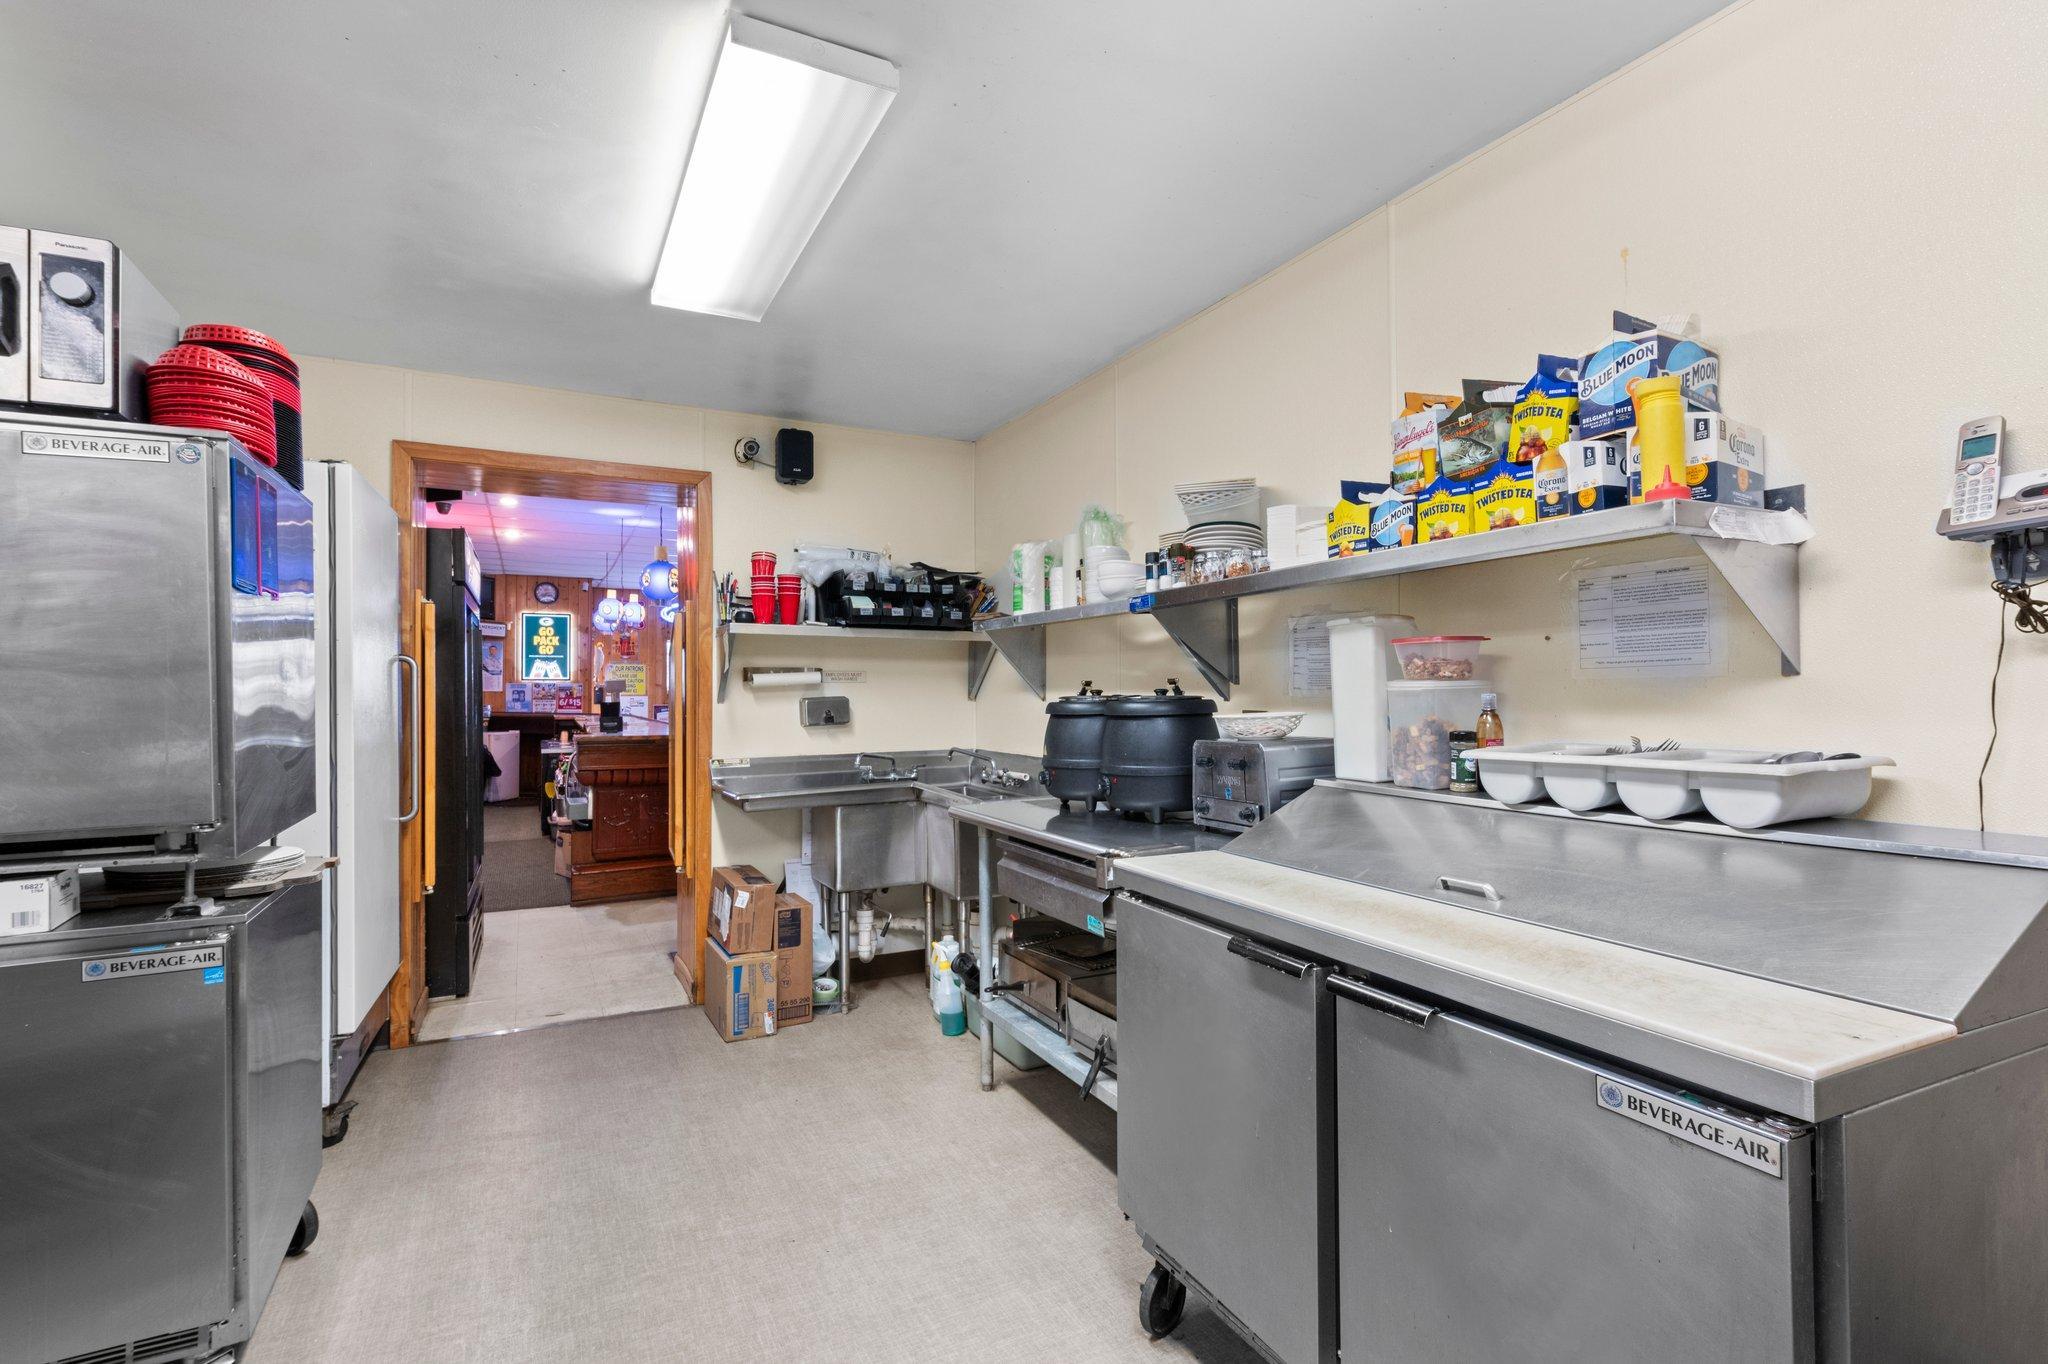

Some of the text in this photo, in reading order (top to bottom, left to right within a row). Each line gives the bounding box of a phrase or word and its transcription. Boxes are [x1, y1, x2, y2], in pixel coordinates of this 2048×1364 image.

[1581, 344, 1655, 398] BLUE MOON
[1692, 362, 1717, 386] MOON
[1514, 406, 1564, 424] TWISTED TEA
[1582, 412, 1606, 424] BELGIAN
[1699, 421, 1705, 430] 6
[52, 438, 162, 455] BEVERAGE-AIR
[1729, 432, 1755, 456] Corona
[1586, 449, 1592, 458] 6
[1538, 477, 1566, 489] Corona
[1475, 489, 1533, 509] TWISTED TEA
[1371, 504, 1412, 537] BLUE MOON
[1419, 503, 1466, 521] TWISTED TEA
[1329, 525, 1367, 542] TWISTED TEA
[539, 627, 554, 636] GO
[533, 636, 560, 645] PACK
[539, 645, 554, 655] GO
[20, 882, 43, 890] 16827
[110, 952, 217, 973] BEVERAGE-AIR
[1627, 1094, 1772, 1165] BEVERAGE-AIR
